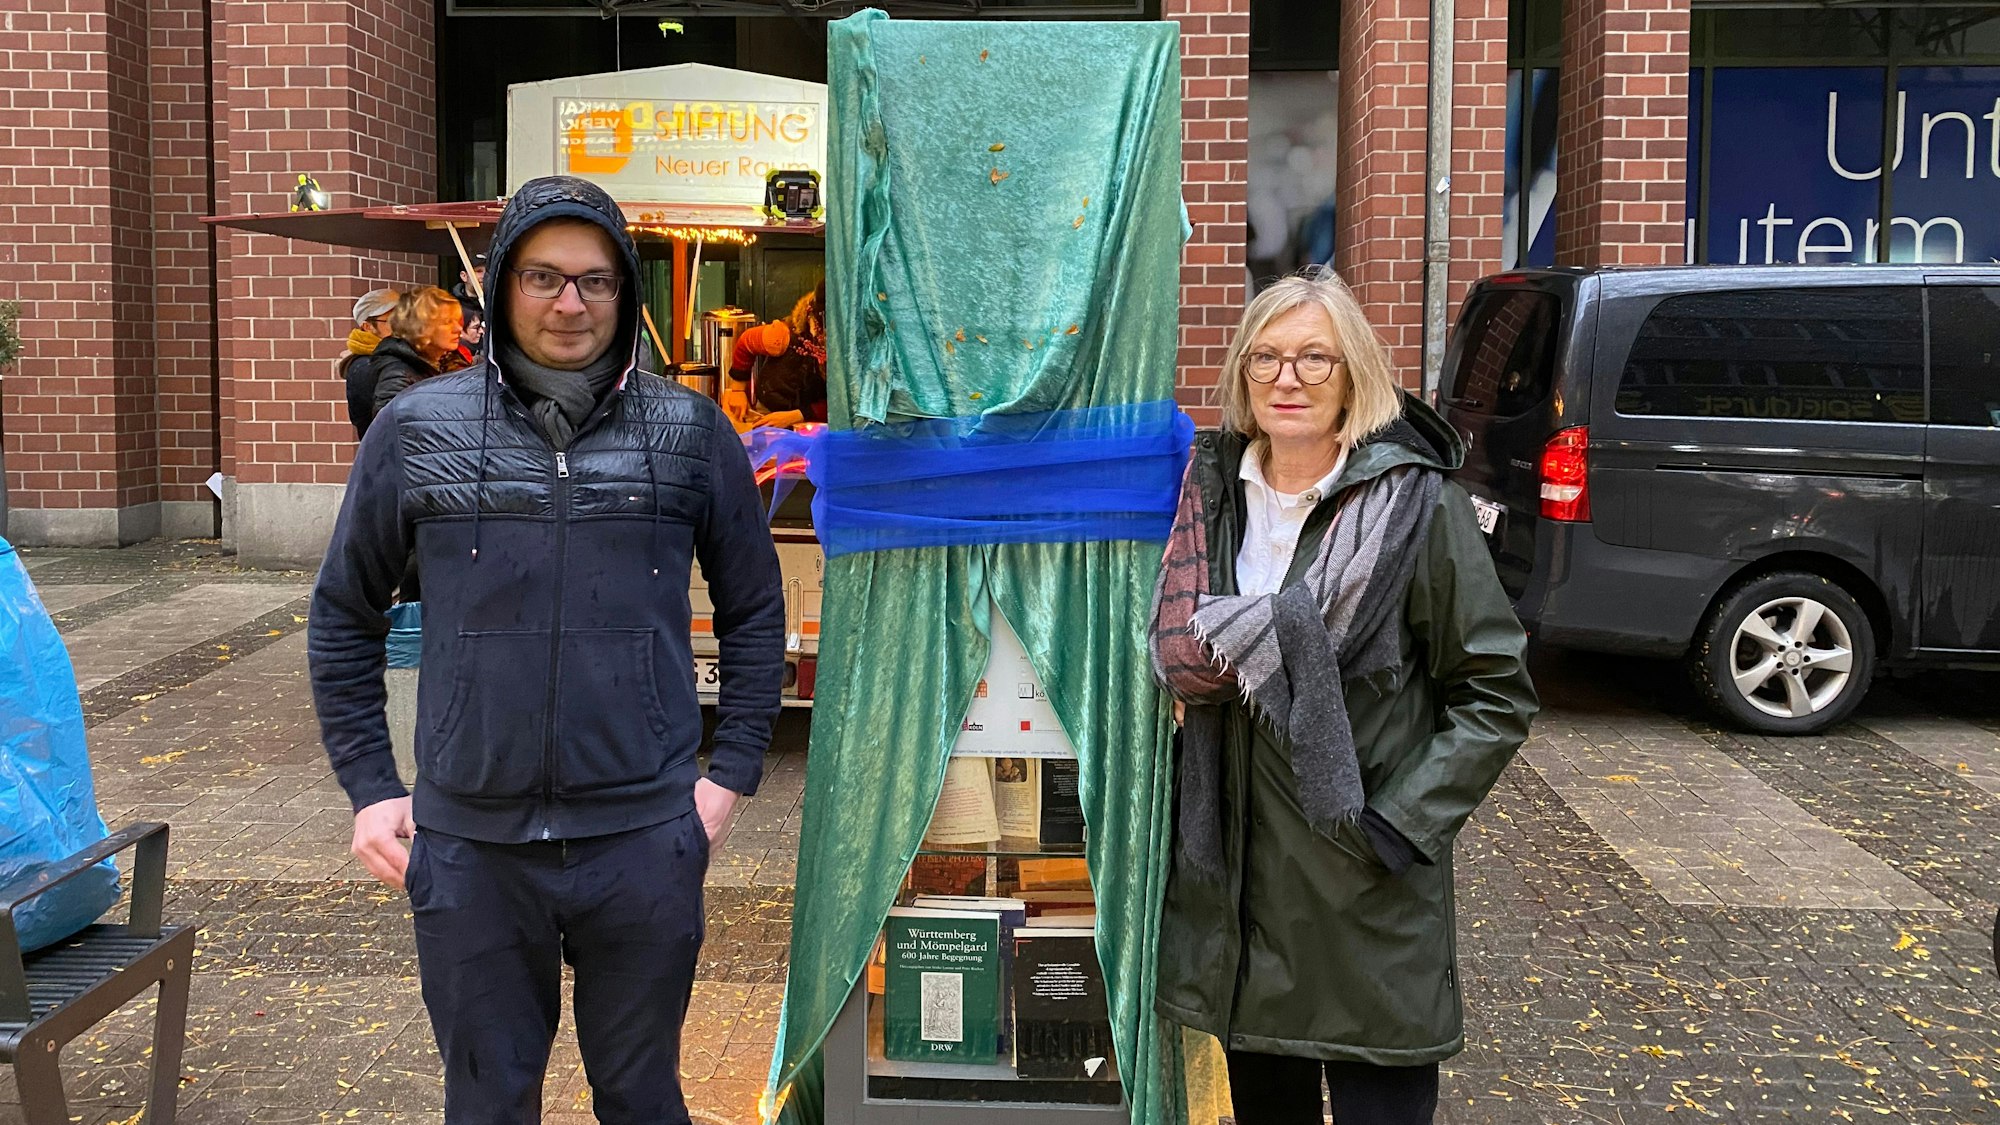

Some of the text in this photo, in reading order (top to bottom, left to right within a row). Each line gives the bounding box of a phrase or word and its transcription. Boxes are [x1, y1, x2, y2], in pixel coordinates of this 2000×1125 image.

[655, 110, 808, 143] STIFTUNG
[656, 155, 729, 176] Neuer
[908, 928, 977, 941] Württemberg
[897, 940, 988, 952] und Mömpelgard
[918, 953, 940, 962] Jahre
[941, 953, 983, 963] Begegnung
[930, 1043, 954, 1052] DRW
